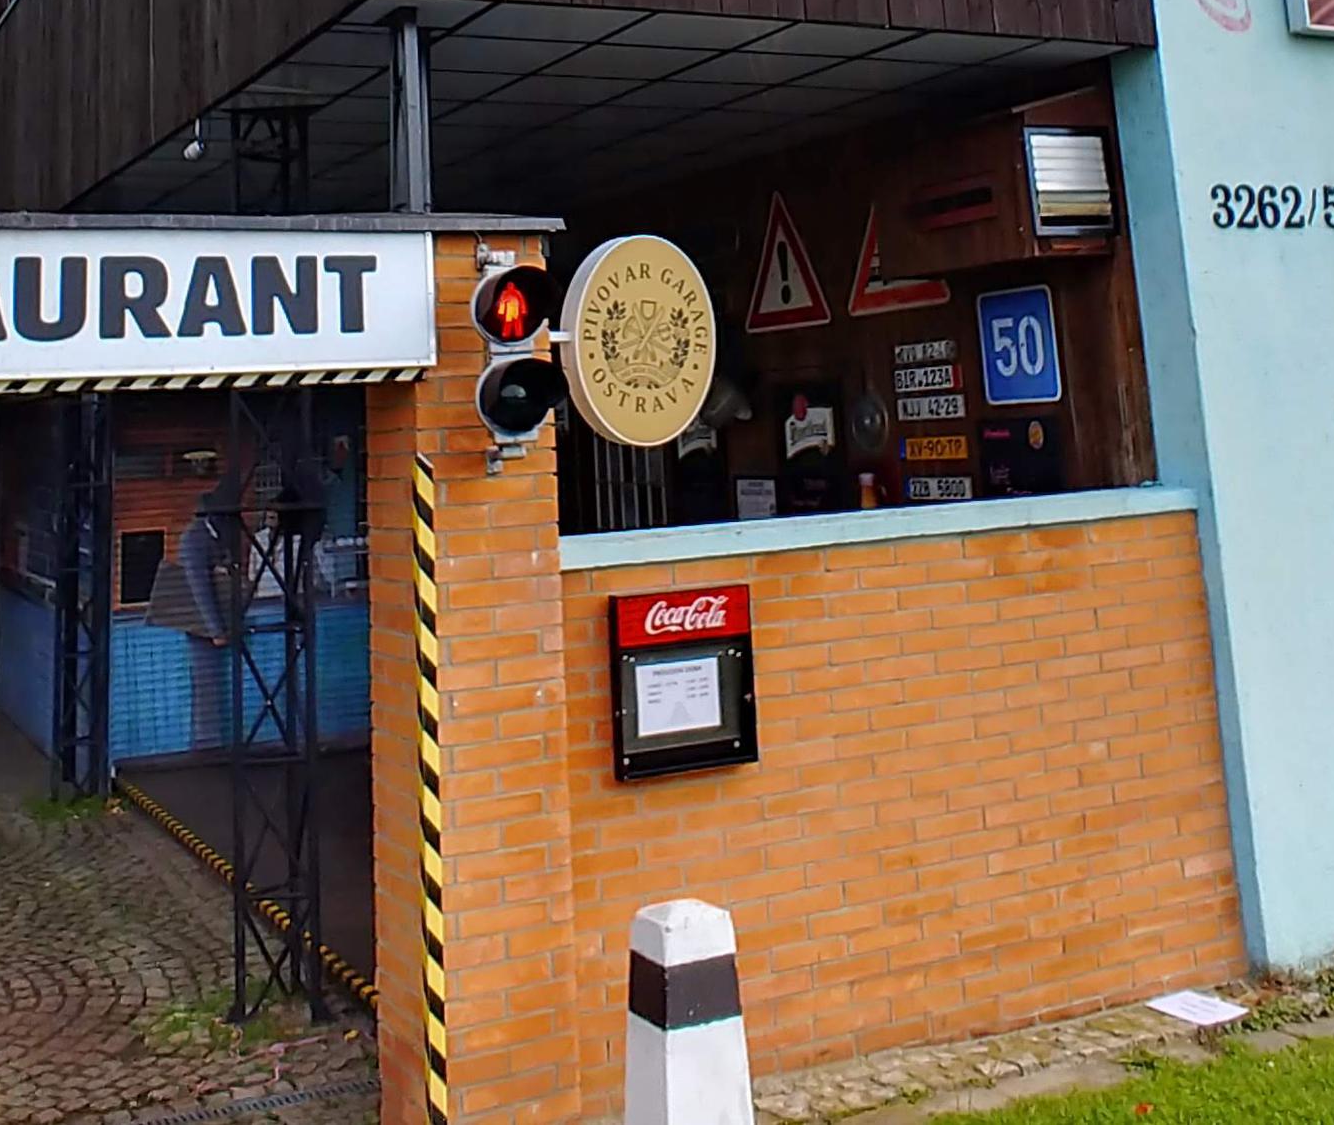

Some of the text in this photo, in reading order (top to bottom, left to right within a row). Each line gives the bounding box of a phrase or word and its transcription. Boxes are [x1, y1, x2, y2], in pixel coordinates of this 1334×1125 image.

[583, 263, 708, 356] PIVOVAR GARAGE
[991, 315, 1044, 377] 50
[592, 368, 695, 413] OSTRAVA
